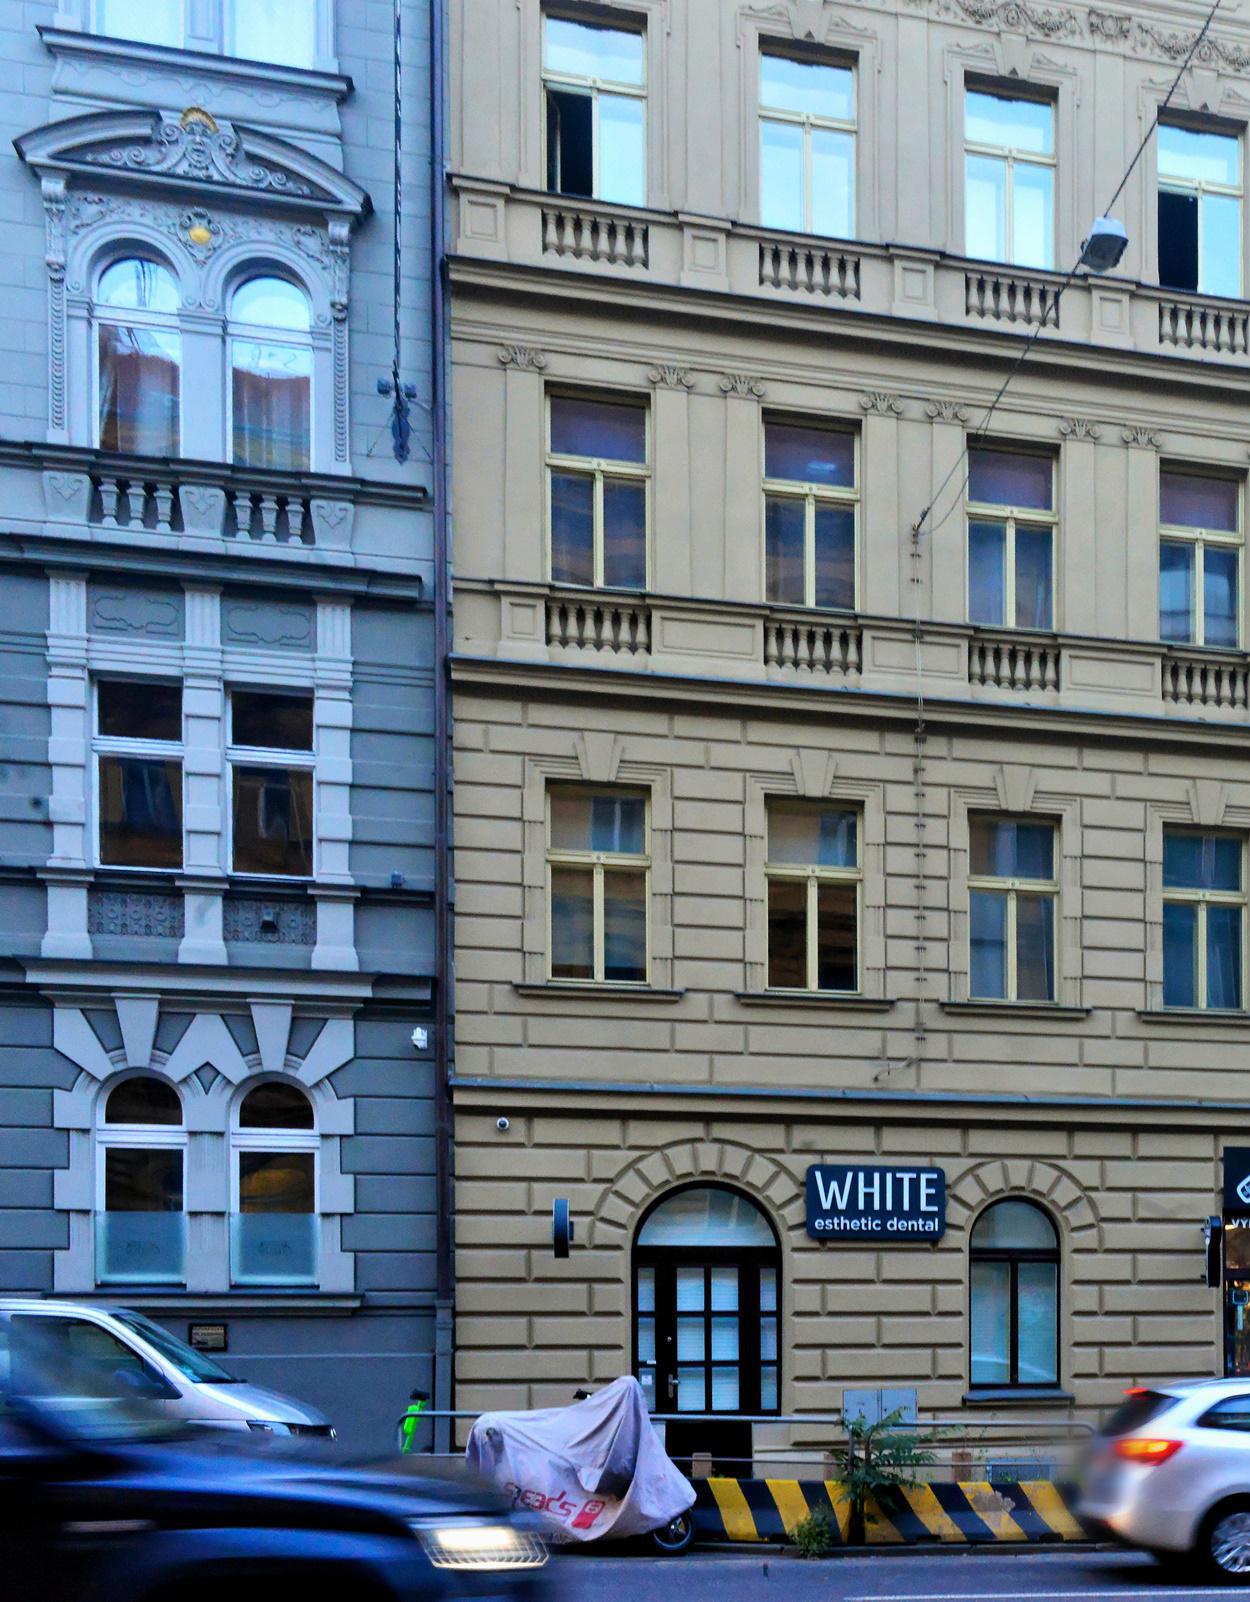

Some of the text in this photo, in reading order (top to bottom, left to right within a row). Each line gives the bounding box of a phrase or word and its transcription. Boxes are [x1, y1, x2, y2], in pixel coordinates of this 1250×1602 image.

[814, 1170, 939, 1212] WHITE
[814, 1216, 939, 1232] esthetic dental
